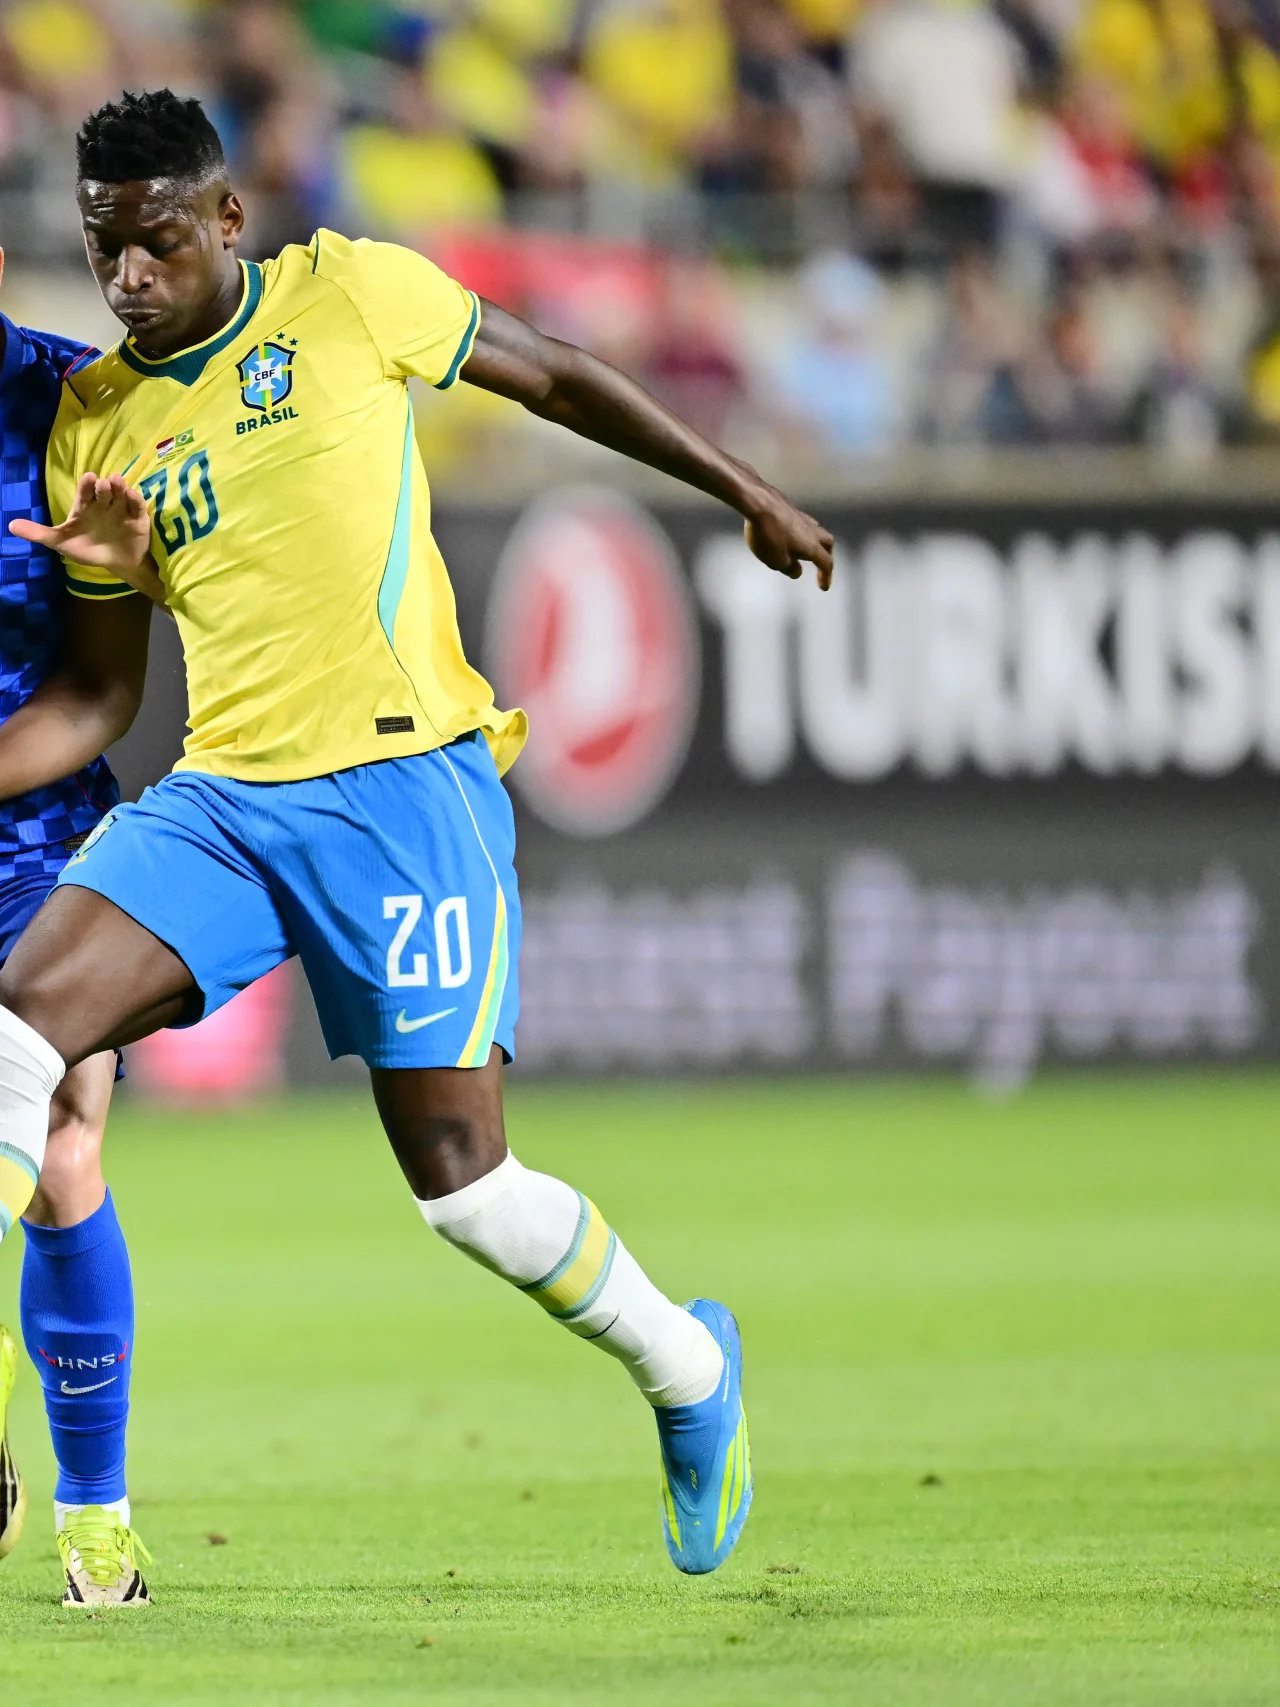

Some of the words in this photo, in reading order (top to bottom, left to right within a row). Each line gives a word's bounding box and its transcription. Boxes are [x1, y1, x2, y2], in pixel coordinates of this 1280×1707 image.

[254, 368, 276, 382] CBF
[235, 406, 299, 436] BRASIL
[138, 447, 220, 557] 20
[696, 532, 1280, 782] TURKIS
[382, 894, 472, 989] 20
[57, 1353, 115, 1370] HNS
